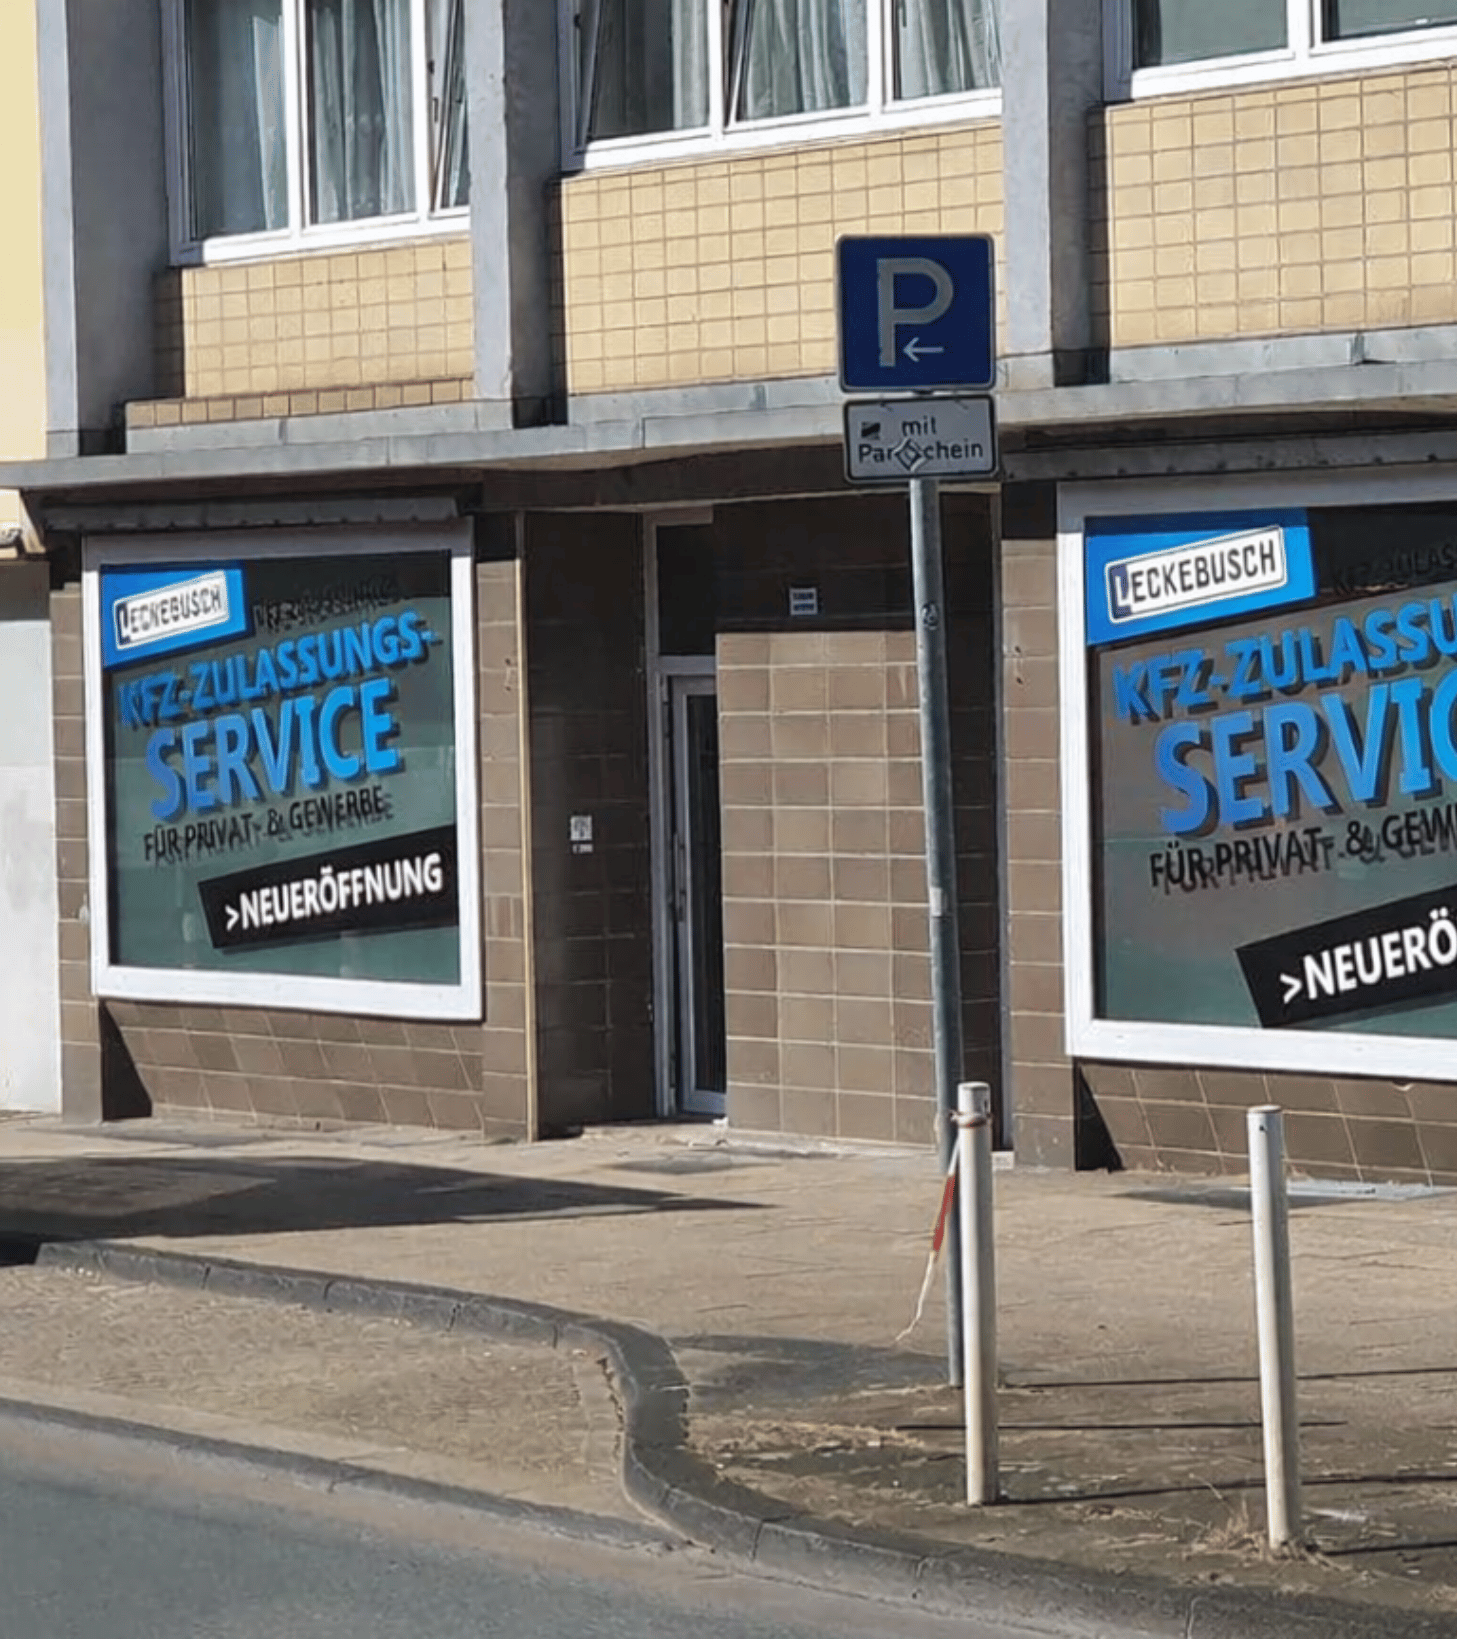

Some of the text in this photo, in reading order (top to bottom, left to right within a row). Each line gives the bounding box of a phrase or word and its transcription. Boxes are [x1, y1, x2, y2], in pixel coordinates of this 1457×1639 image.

[876, 257, 954, 367] P
[859, 438, 984, 464] Parchein
[1114, 539, 1277, 607] LECKEBUSCH
[118, 610, 436, 727] KFZ-ZULASSUNGS-
[144, 677, 399, 822] SERVICE
[143, 821, 178, 861] FÜR
[267, 808, 284, 836] &
[289, 784, 384, 832] GEWERBE
[1150, 841, 1212, 887] FÜR
[1345, 820, 1367, 856] &
